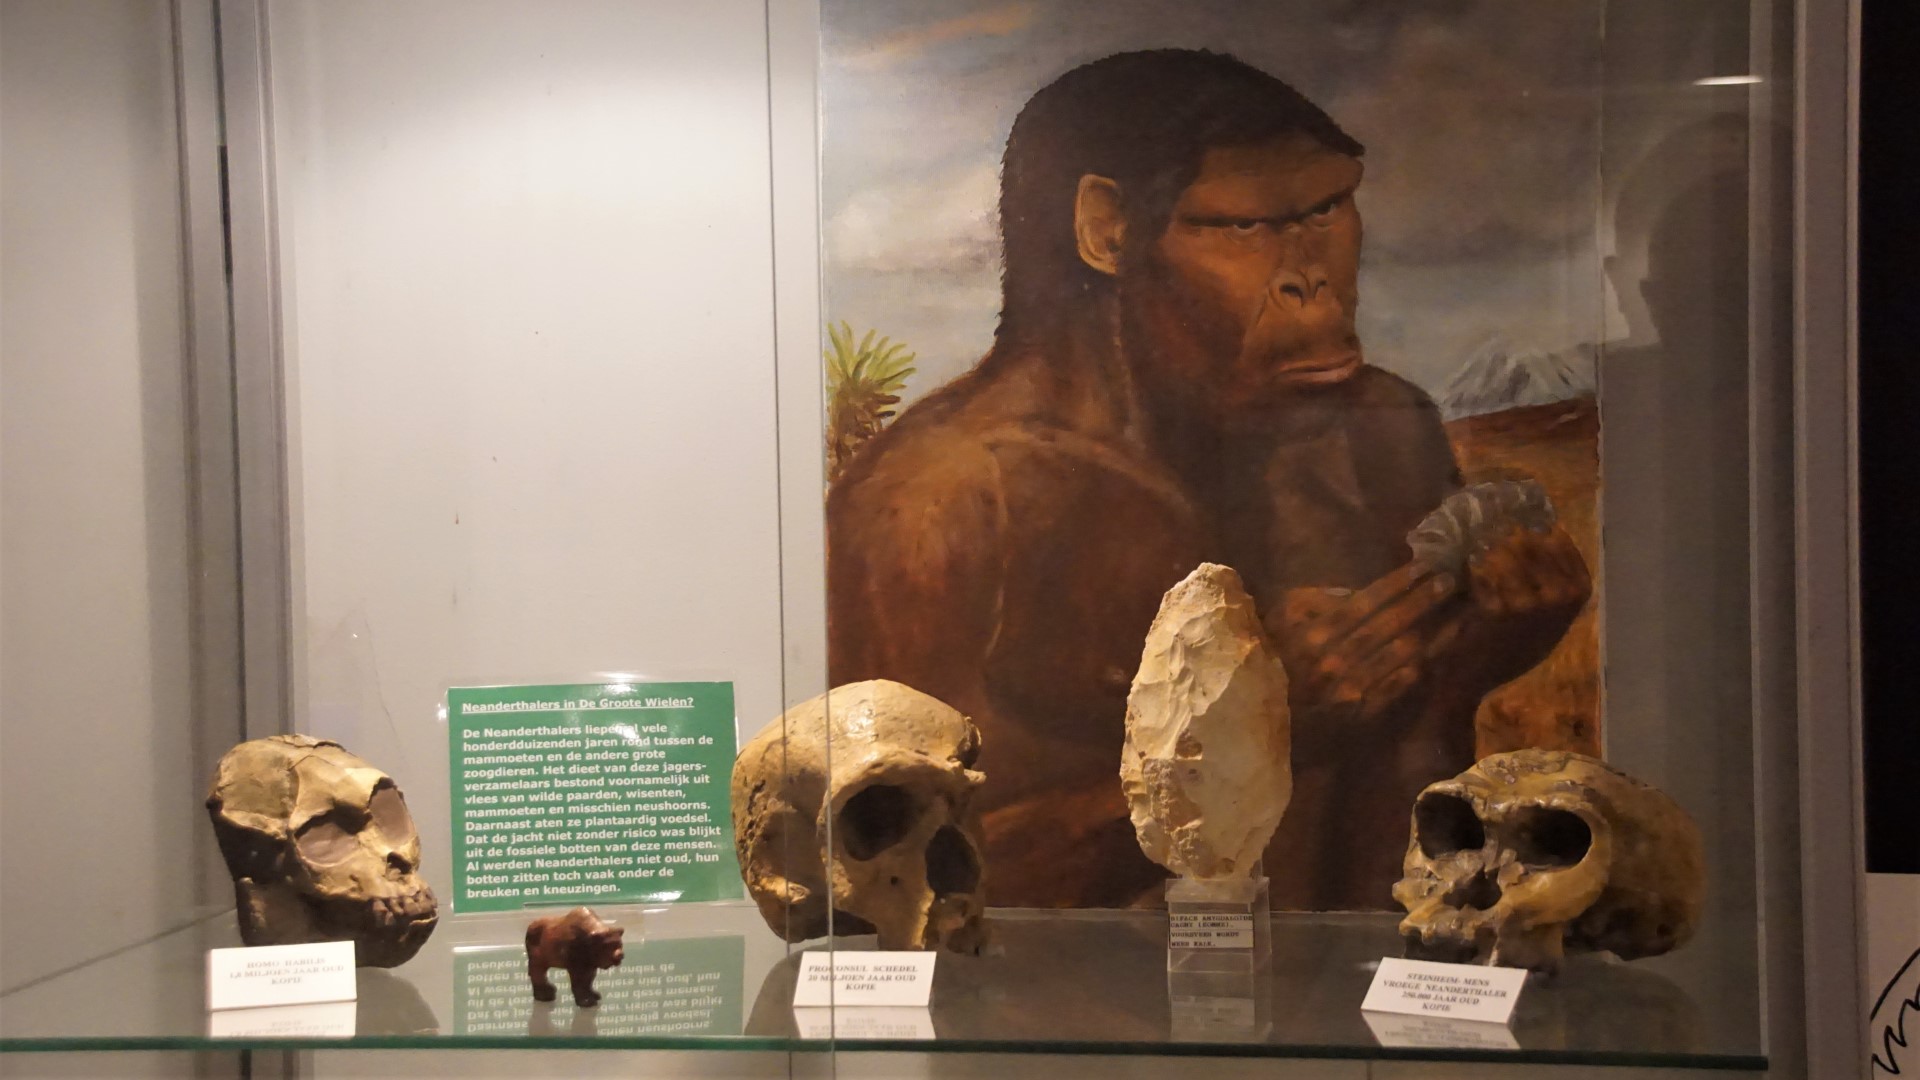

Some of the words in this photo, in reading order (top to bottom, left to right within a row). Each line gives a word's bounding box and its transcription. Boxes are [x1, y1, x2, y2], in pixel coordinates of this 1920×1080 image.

[462, 700, 560, 712] Neanderthalers
[564, 700, 575, 709] in
[579, 699, 596, 709] De
[599, 698, 641, 708] Groote
[645, 697, 694, 707] Wielen?
[463, 729, 480, 738] De
[484, 725, 582, 737] Neanderthalers
[642, 723, 668, 733] vele
[463, 738, 581, 751] honderdduizenden
[585, 737, 618, 749] jaren
[654, 736, 695, 746] tussen
[698, 735, 714, 745] de
[463, 753, 543, 765] mammoeten
[547, 753, 563, 761] en
[566, 751, 582, 761] de
[585, 750, 629, 760] andere
[632, 749, 666, 761] grote
[464, 766, 539, 779] zoogdieren.
[543, 765, 565, 774] Het
[568, 764, 600, 774] dieet
[604, 764, 627, 773] van
[630, 762, 660, 772] deze
[662, 761, 707, 773] jagers-
[464, 780, 551, 791] verzamelaars
[554, 777, 605, 788] bestond
[608, 774, 690, 786] voornamelijk
[693, 774, 710, 784] uit
[465, 794, 498, 804] vlees
[502, 794, 525, 803] van
[529, 791, 563, 801] wilde
[567, 789, 622, 802] paarden,
[626, 788, 686, 799] wisenten,
[465, 806, 545, 818] mammoeten
[549, 805, 564, 814] en
[568, 802, 631, 813] misschien
[635, 801, 711, 812] neushoorns.
[465, 820, 531, 831] Daarnaast
[535, 819, 563, 828] aten
[567, 818, 581, 827] ze
[585, 814, 657, 828] plantaardig
[661, 813, 711, 823] voedsel.
[465, 834, 488, 844] Dat
[492, 833, 508, 843] de
[511, 832, 544, 844] jacht
[547, 831, 572, 841] niet
[576, 829, 619, 840] zonder
[623, 828, 657, 838] risico
[661, 828, 685, 837] was
[689, 826, 721, 837] blijkt
[466, 848, 484, 858] uit
[487, 847, 503, 857] de
[507, 845, 556, 856] fossiele
[559, 844, 601, 854] botten
[605, 843, 627, 852] van
[631, 841, 661, 851] deze
[664, 841, 717, 850] mensen.
[466, 861, 479, 872] Al
[483, 860, 531, 870] werden
[535, 854, 633, 868] Neanderthalers
[637, 854, 661, 864] niet
[664, 853, 692, 864] oud,
[695, 852, 719, 862] hun
[466, 874, 509, 885] botten
[512, 872, 550, 883] zitten
[553, 870, 581, 880] toch
[585, 869, 614, 880] vaak
[618, 868, 655, 878] onder
[658, 867, 674, 877] de
[467, 887, 520, 898] breuken
[524, 887, 539, 896] en
[543, 883, 621, 895] kneuzingen.
[1383, 980, 1420, 990] VROEGE
[1425, 984, 1507, 998] NEANDERTHALER
[1464, 977, 1490, 986] MENS
[1422, 1002, 1451, 1011] KOPIE
[1432, 994, 1457, 1003] JAAR
[1459, 996, 1479, 1005] OUD
